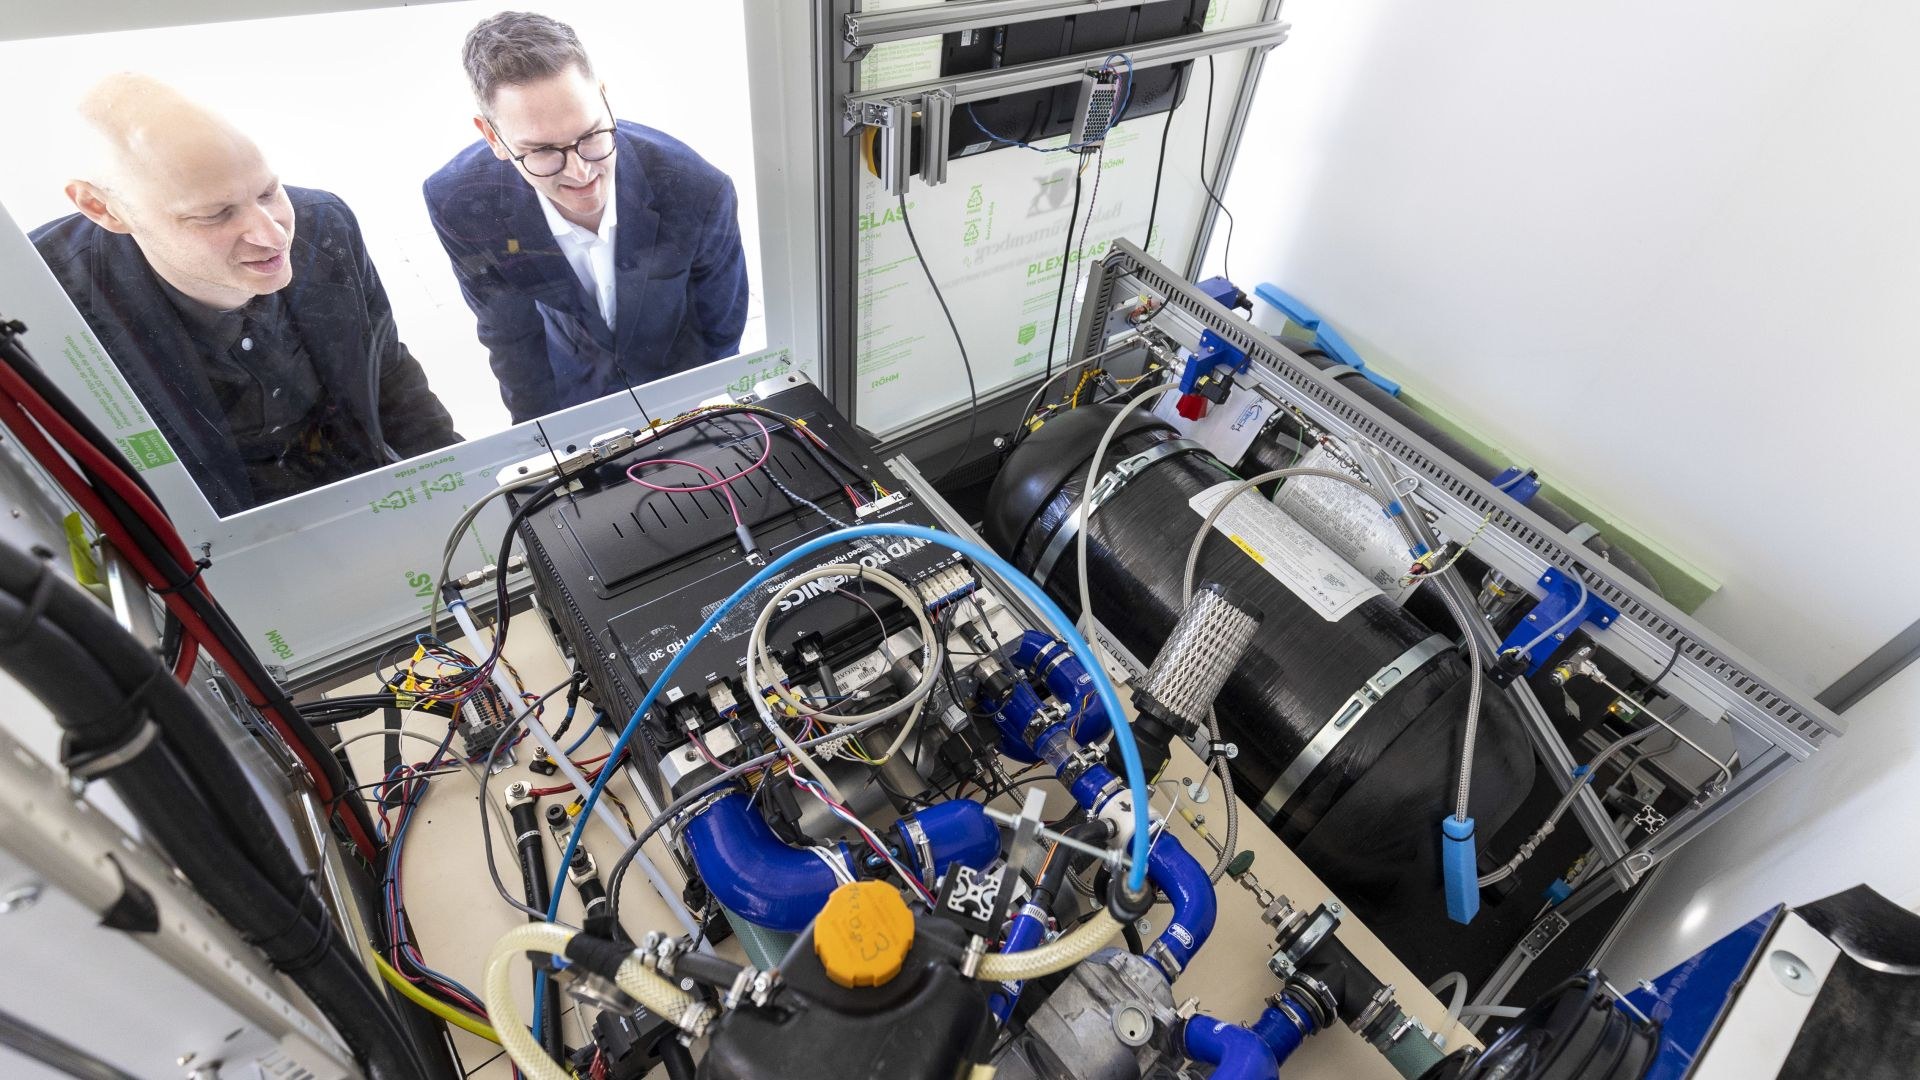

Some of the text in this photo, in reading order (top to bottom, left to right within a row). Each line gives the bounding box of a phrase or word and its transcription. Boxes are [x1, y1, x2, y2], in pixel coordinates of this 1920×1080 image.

[394, 455, 455, 479] Service Side
[265, 629, 294, 660] RÖHM
[648, 650, 666, 662] 30
